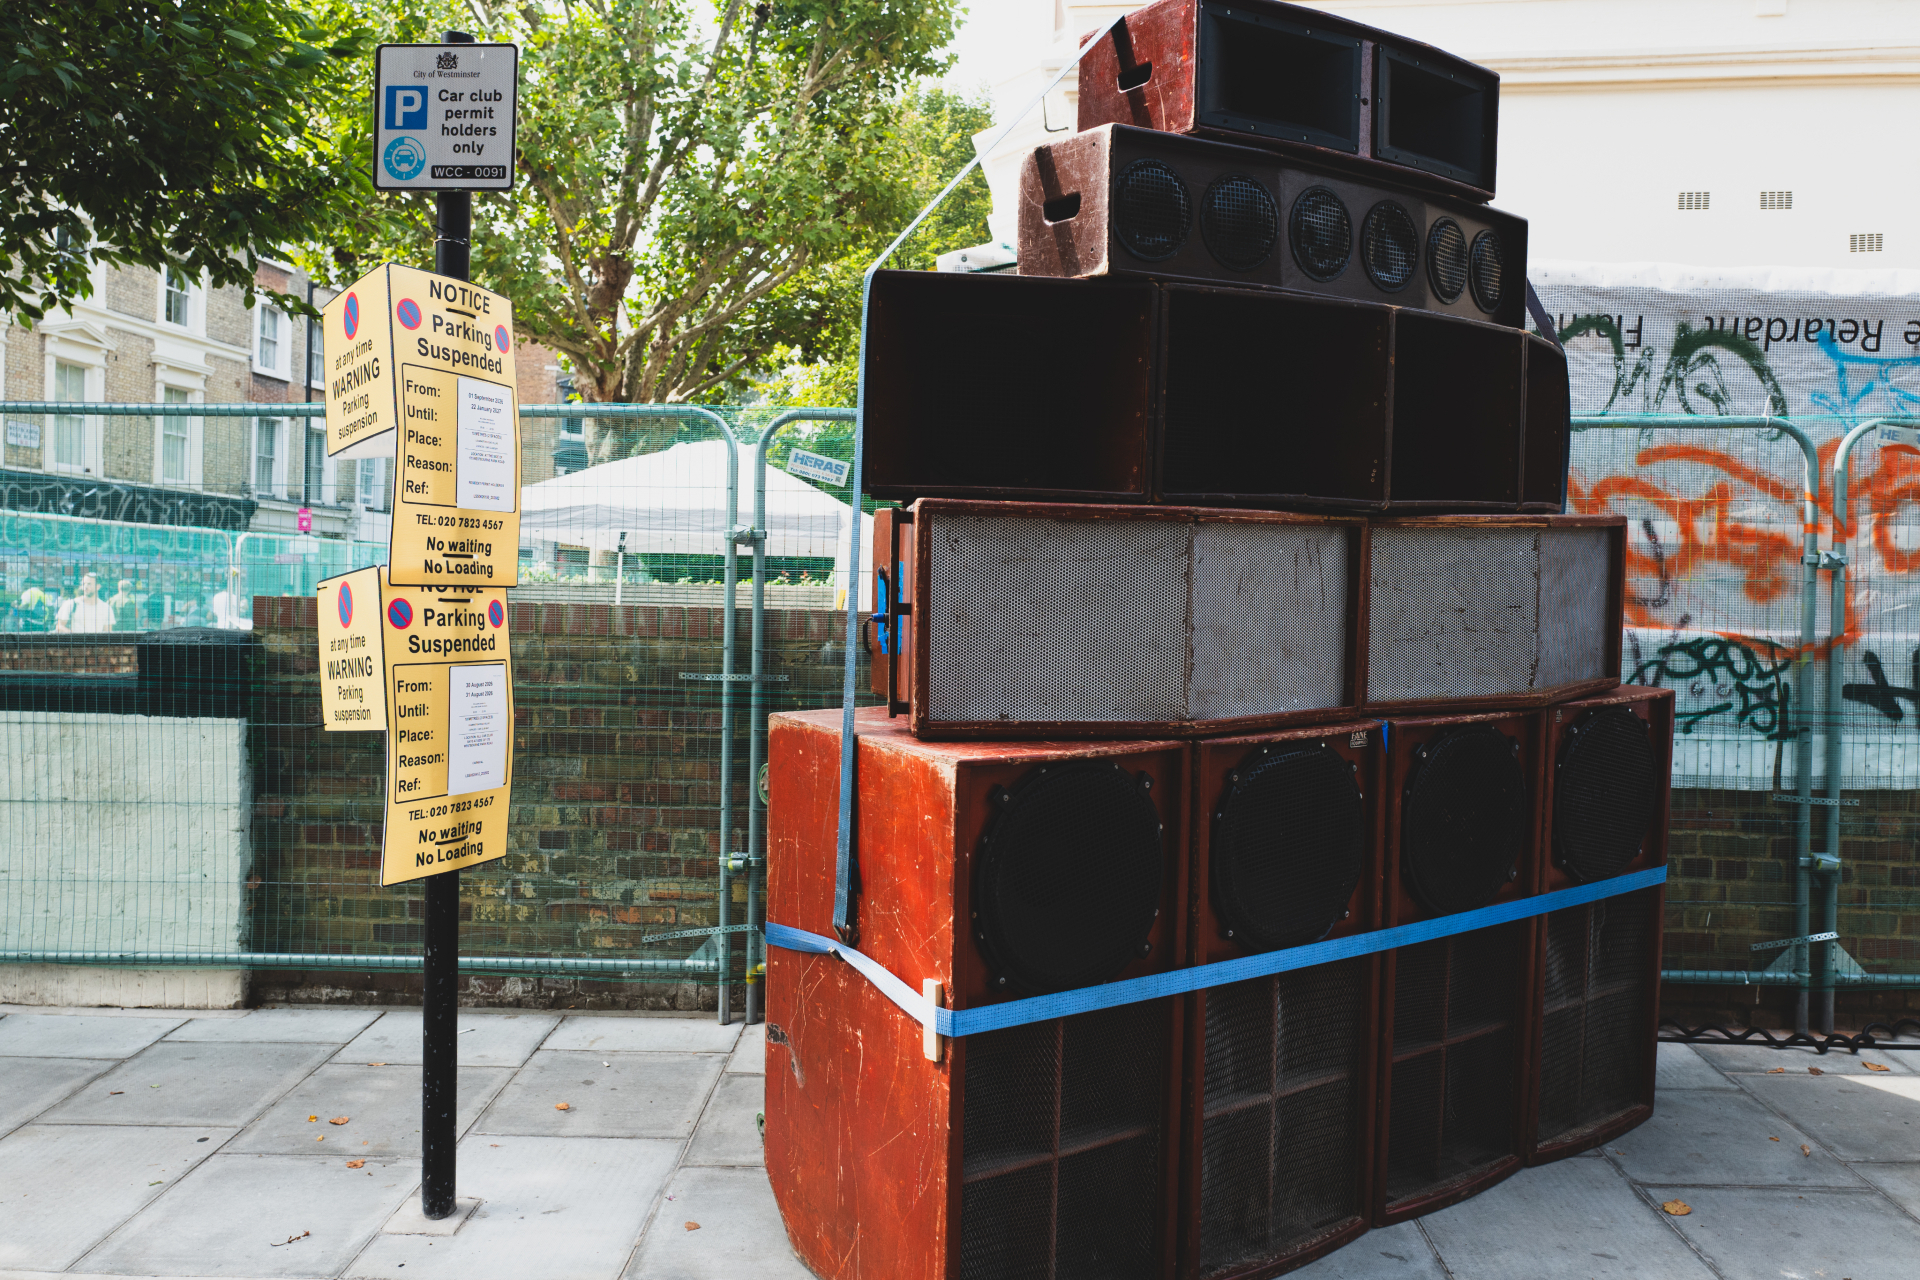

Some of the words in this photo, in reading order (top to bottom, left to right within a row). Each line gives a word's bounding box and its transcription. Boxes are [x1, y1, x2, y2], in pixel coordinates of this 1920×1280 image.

[413, 70, 426, 80] City
[428, 70, 435, 78] of
[438, 89, 464, 102] Car
[469, 89, 503, 102] club
[395, 90, 422, 127] P
[445, 106, 494, 121] permit
[441, 123, 497, 136] holders
[453, 141, 484, 156] only
[434, 167, 463, 177] WCC
[475, 167, 503, 177] 0091
[430, 279, 490, 314] NOTICE
[432, 314, 492, 351] Parking
[335, 354, 342, 371] at
[342, 349, 354, 365] any
[356, 339, 373, 358] time
[417, 337, 502, 375] Suspended
[332, 357, 380, 401] WARNING
[406, 379, 441, 398] From:
[342, 393, 369, 416] Parking
[407, 404, 437, 422] Until:
[338, 411, 378, 440] suspension
[407, 429, 442, 447] Place:
[407, 454, 453, 472] Reason:
[793, 452, 845, 476] HERAS
[406, 480, 429, 495] Ref:
[416, 514, 436, 526] TEL:
[437, 516, 456, 527] 020
[458, 517, 481, 529] 7823
[482, 519, 504, 530] 4567
[426, 536, 444, 551] No
[448, 539, 492, 557] waiting
[424, 559, 442, 574] No
[446, 560, 493, 579] Loading
[424, 608, 485, 631] Parking
[330, 637, 336, 652] at
[337, 638, 349, 654] any
[350, 633, 366, 649] time
[408, 633, 496, 657] Suspended
[327, 655, 373, 680] WARNING
[338, 685, 363, 703] Parking
[397, 680, 432, 693] From:
[334, 705, 371, 725] suspension
[398, 703, 429, 718] Until:
[399, 729, 434, 743] Place:
[398, 753, 444, 768] Reason:
[398, 778, 421, 793] Ref:
[409, 809, 428, 821] TEL:
[429, 805, 448, 817] 020
[450, 800, 472, 814] 7823
[474, 796, 494, 809] 4567
[418, 829, 436, 844] No
[440, 821, 483, 839] waiting
[416, 852, 434, 867] No
[437, 842, 483, 862] Loading
